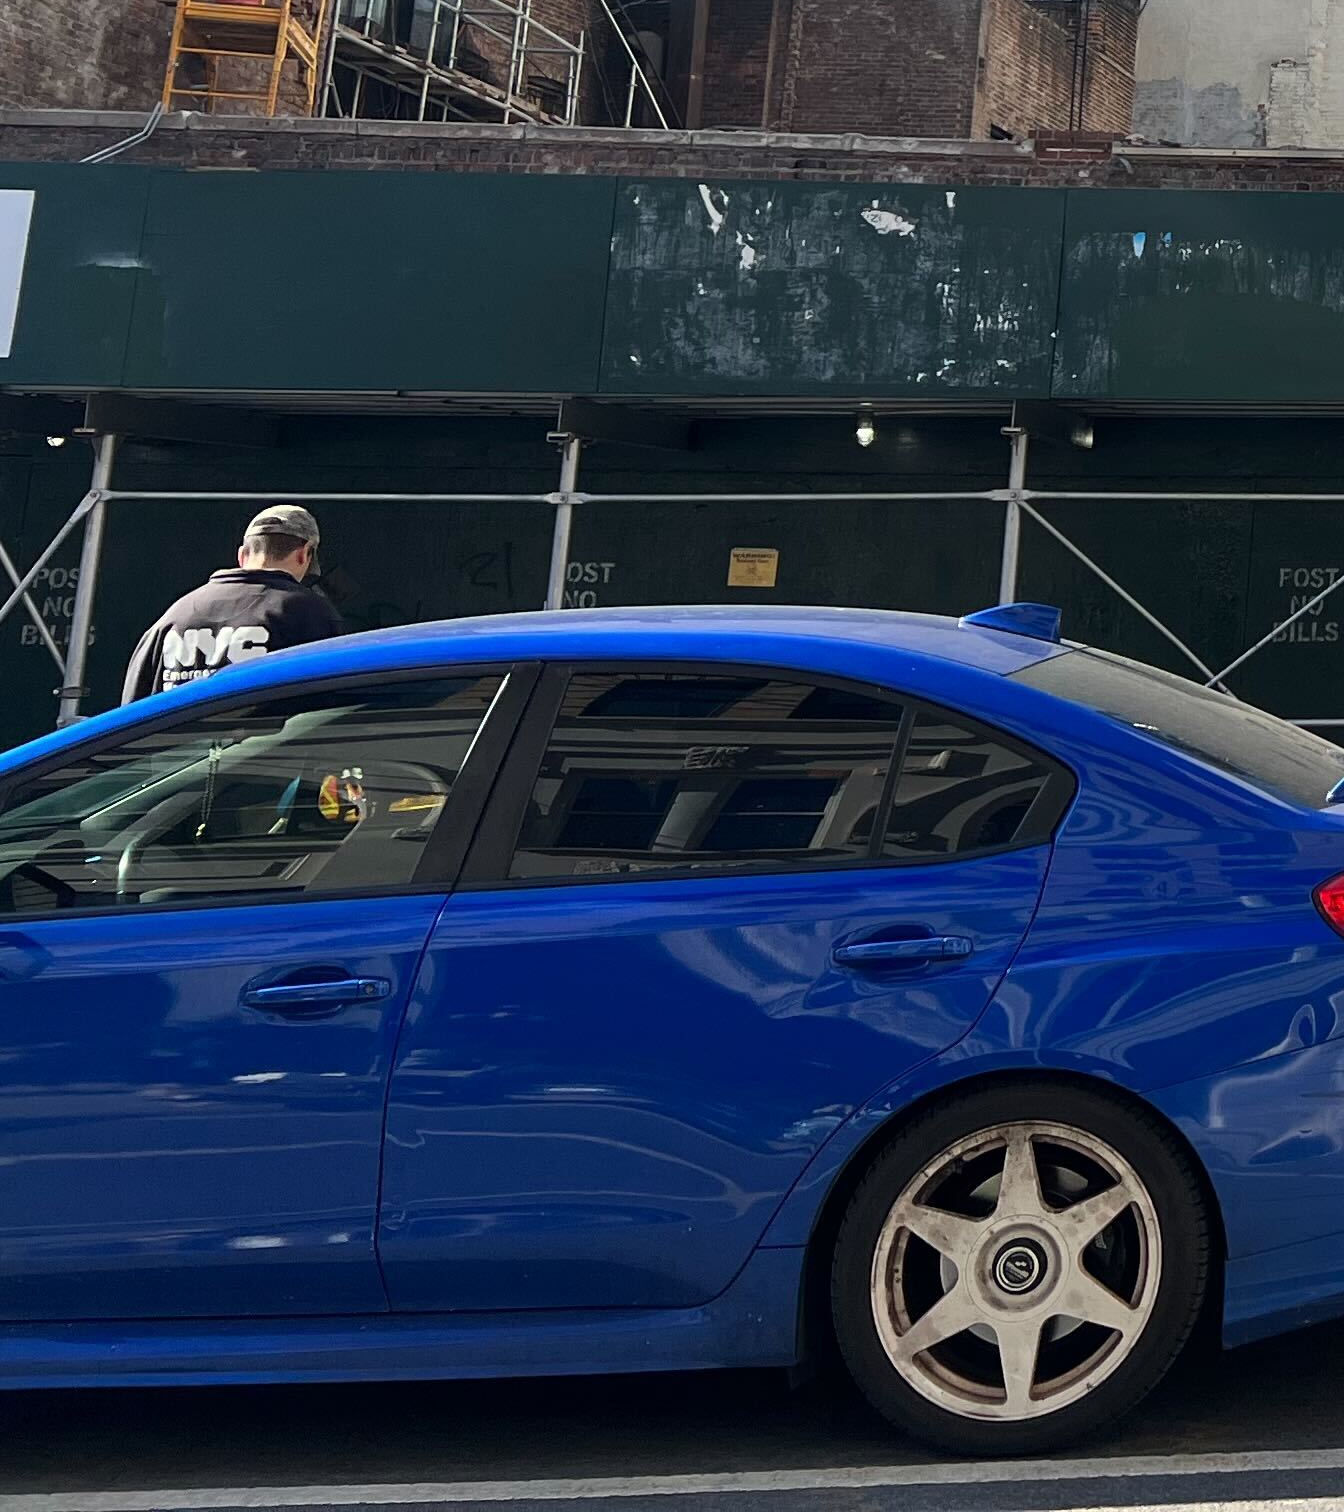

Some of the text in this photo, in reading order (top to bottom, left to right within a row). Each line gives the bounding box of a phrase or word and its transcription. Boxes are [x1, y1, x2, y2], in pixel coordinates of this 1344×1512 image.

[32, 567, 81, 589] POS
[566, 561, 616, 584] OST
[1279, 567, 1340, 589] POST
[163, 626, 270, 669] NYC
